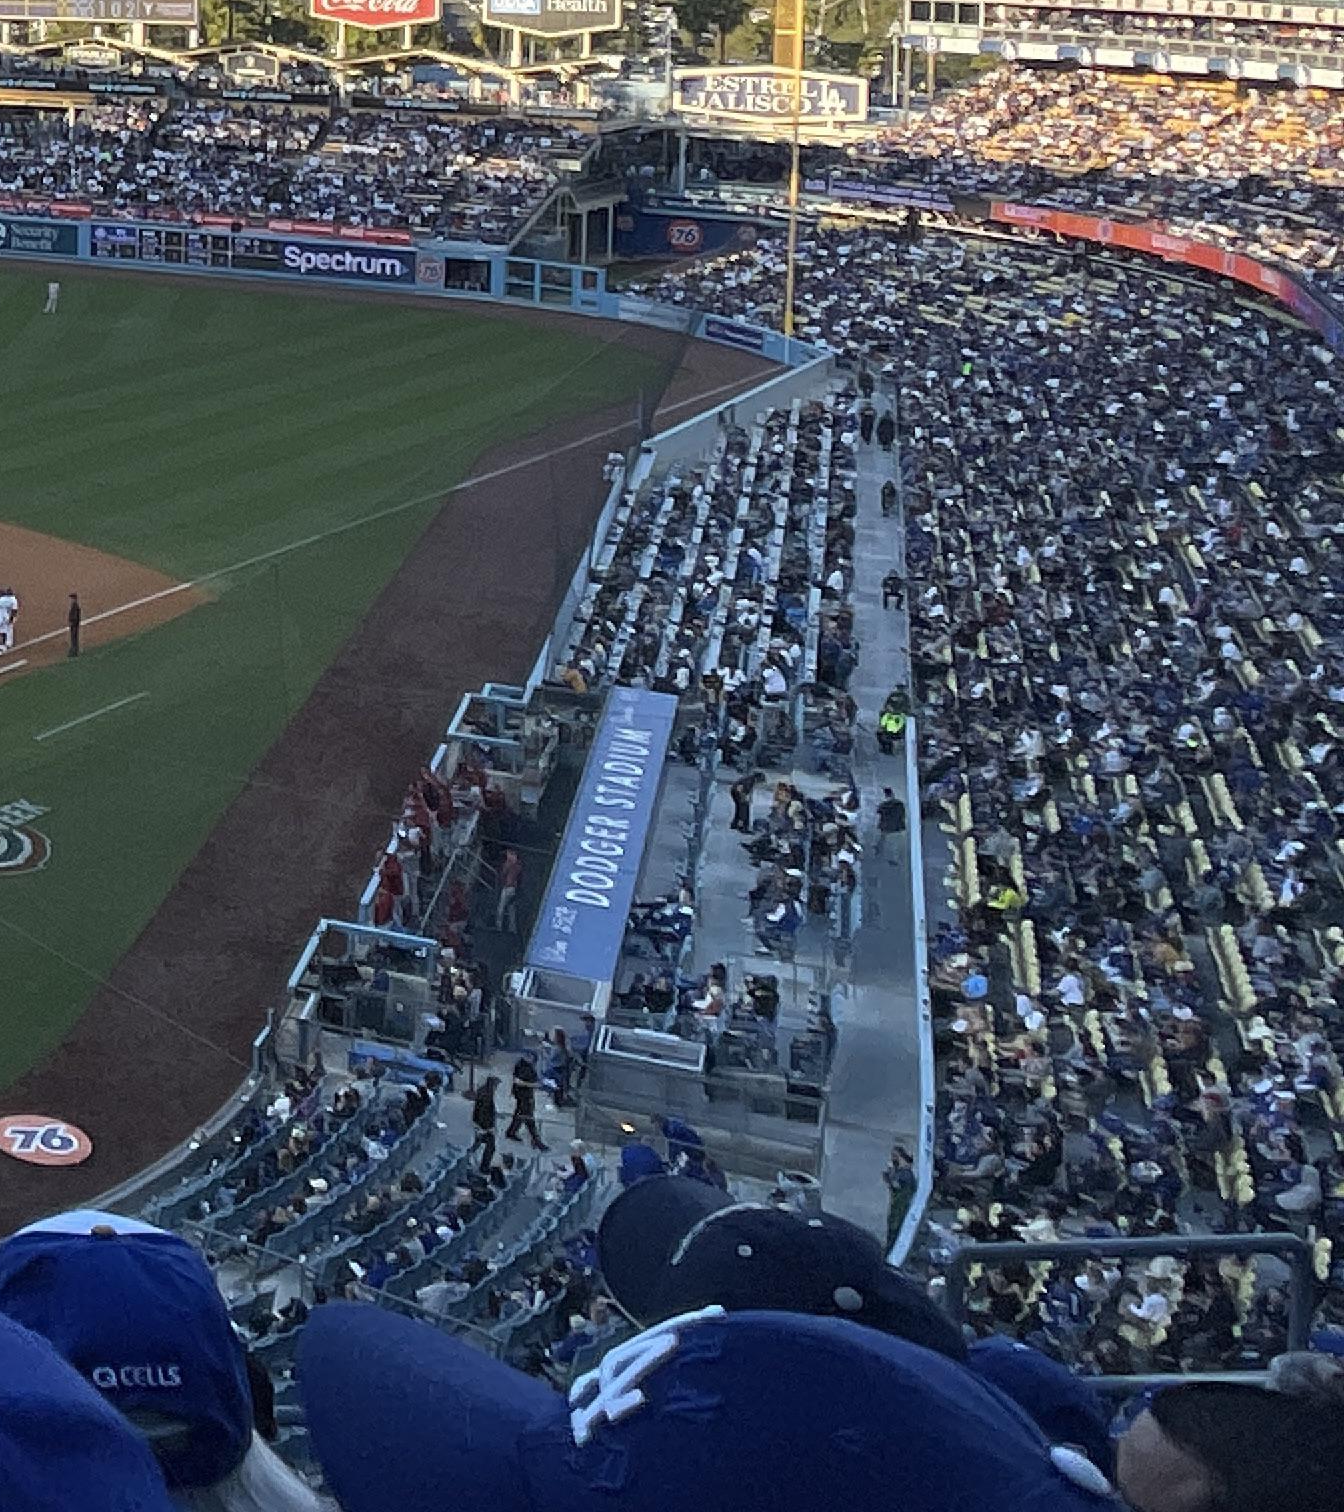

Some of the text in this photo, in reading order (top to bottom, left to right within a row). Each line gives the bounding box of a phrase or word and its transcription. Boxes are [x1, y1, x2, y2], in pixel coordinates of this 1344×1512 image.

[691, 92, 812, 114] JALISCO
[675, 227, 697, 244] 76
[284, 246, 402, 277] Spectrum
[593, 727, 654, 811] STADIUM
[565, 814, 631, 910] DODGER
[4, 1124, 80, 1155] 76
